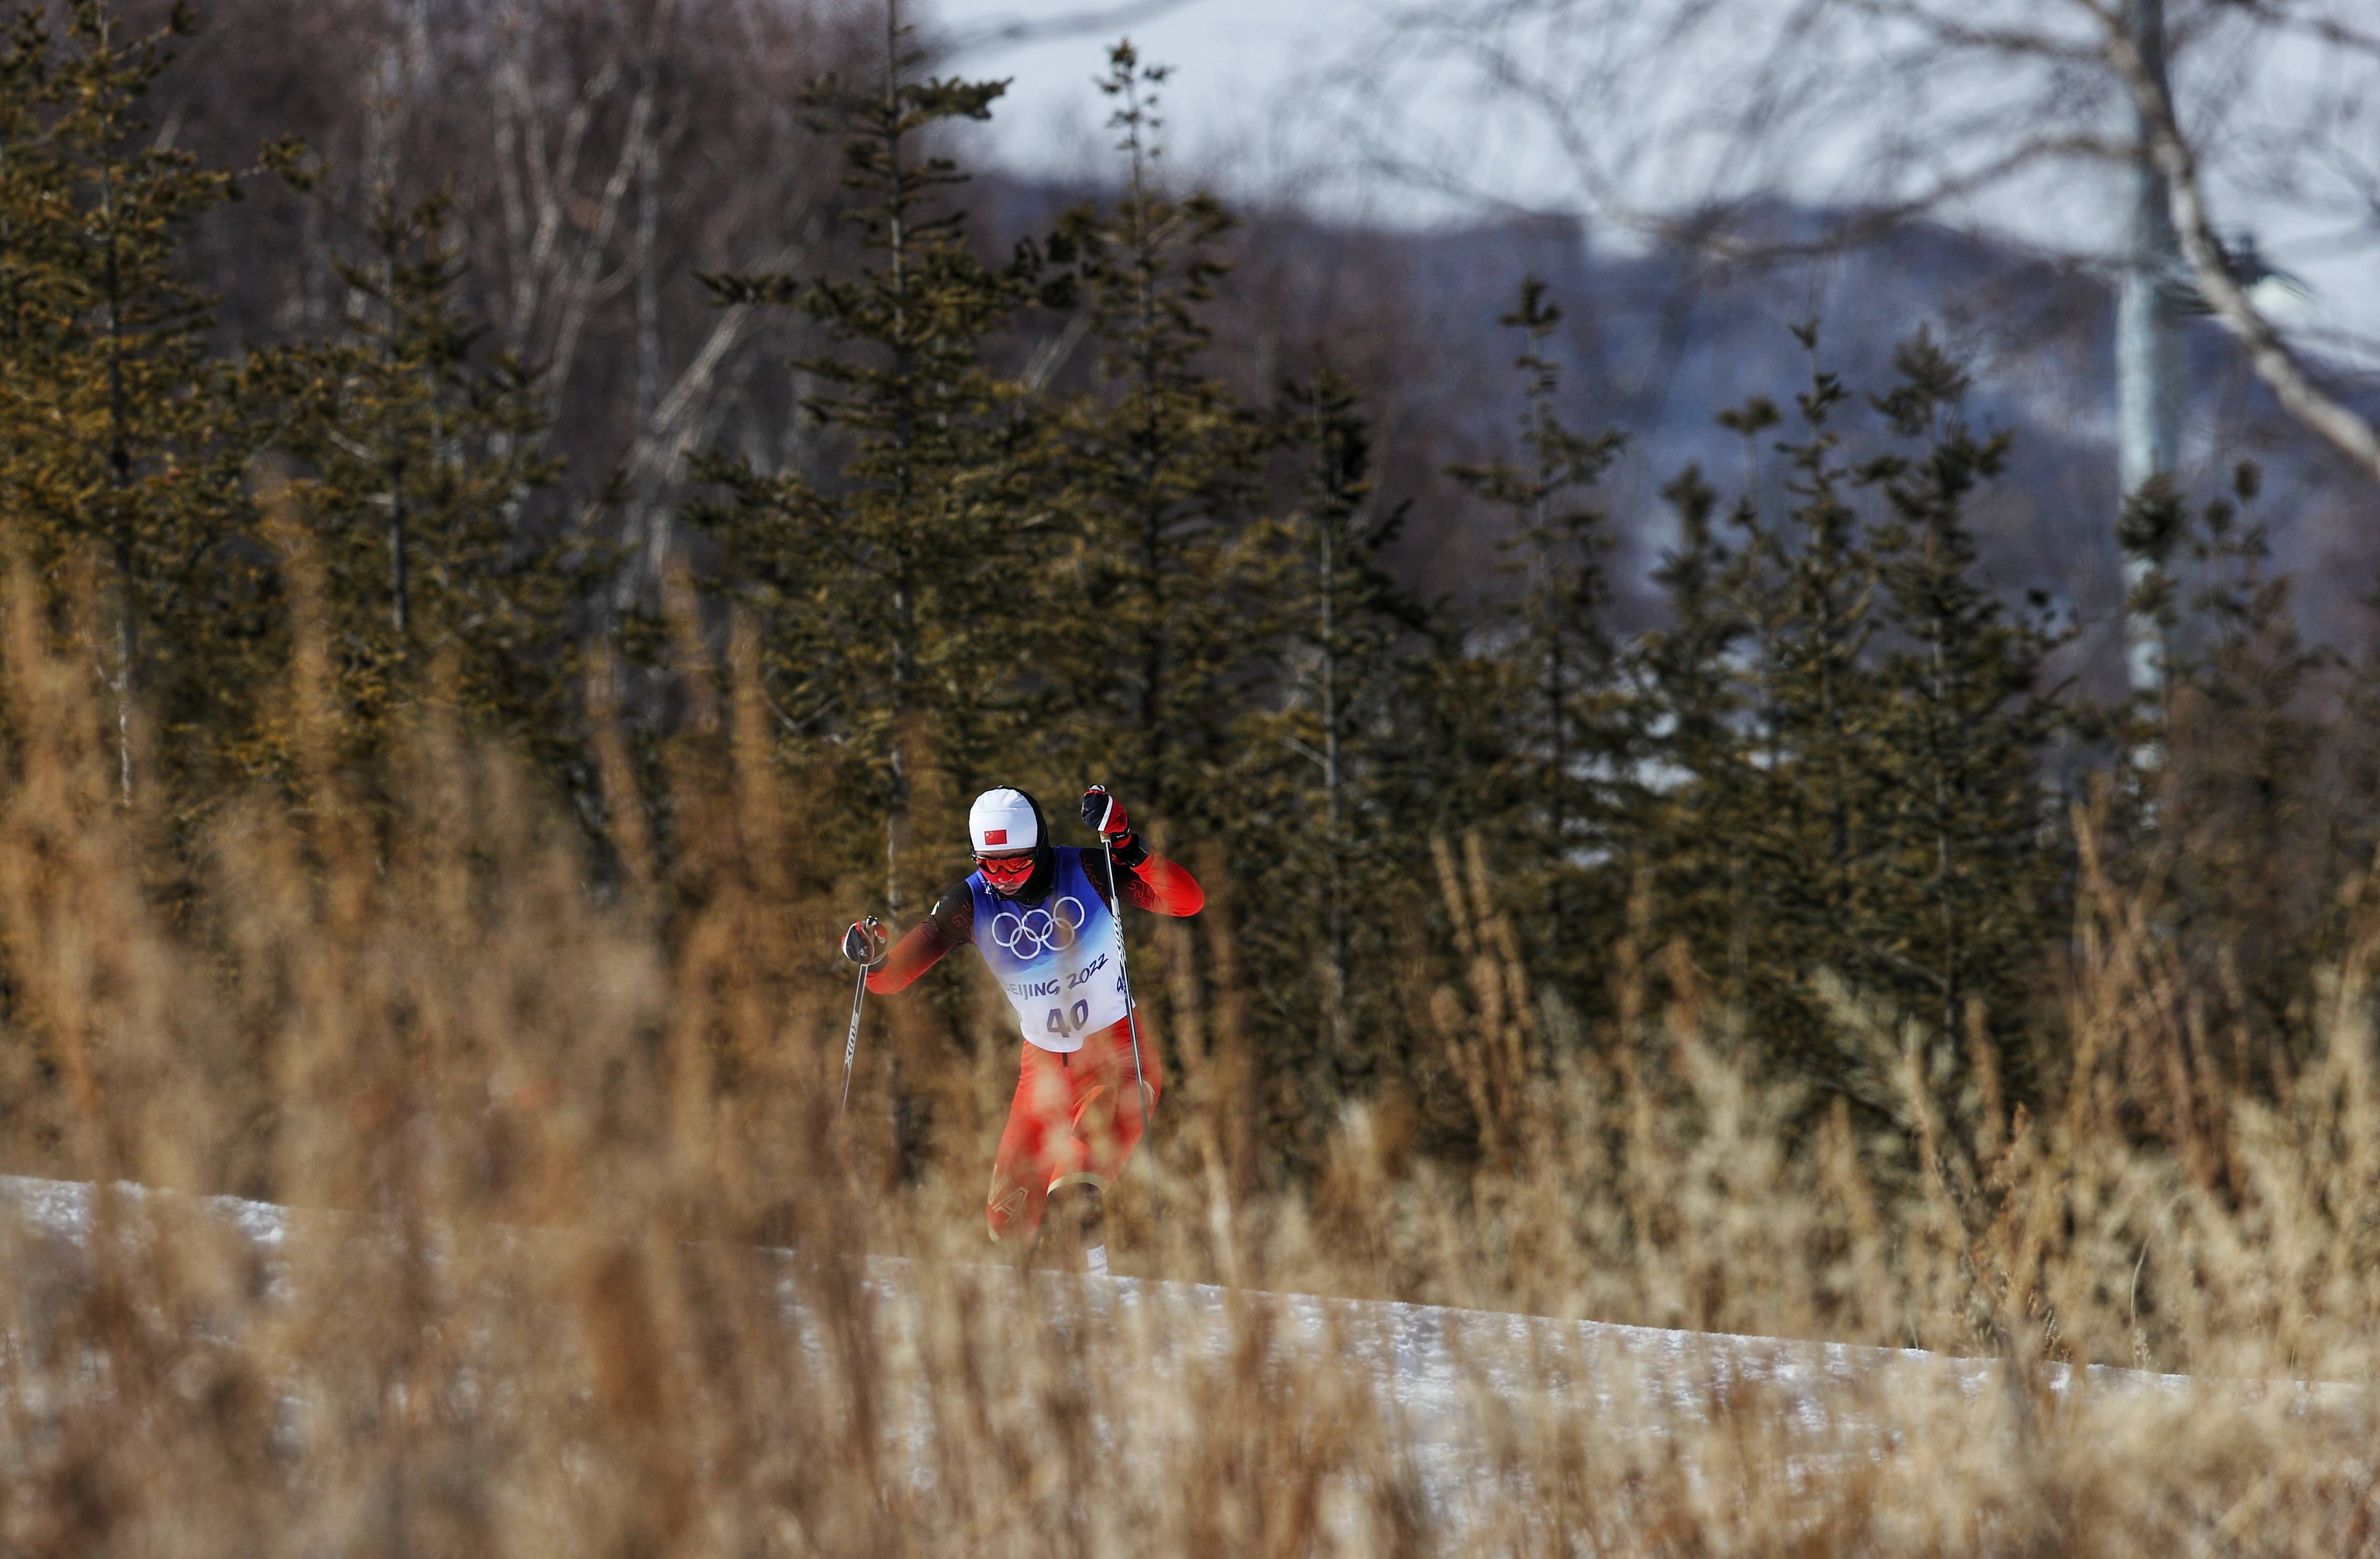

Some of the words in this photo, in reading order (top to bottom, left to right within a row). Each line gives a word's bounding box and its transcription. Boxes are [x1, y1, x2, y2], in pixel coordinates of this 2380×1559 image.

[1066, 953, 1109, 990] 2022
[1117, 976, 1125, 993] 4
[1047, 999, 1089, 1038] 40
